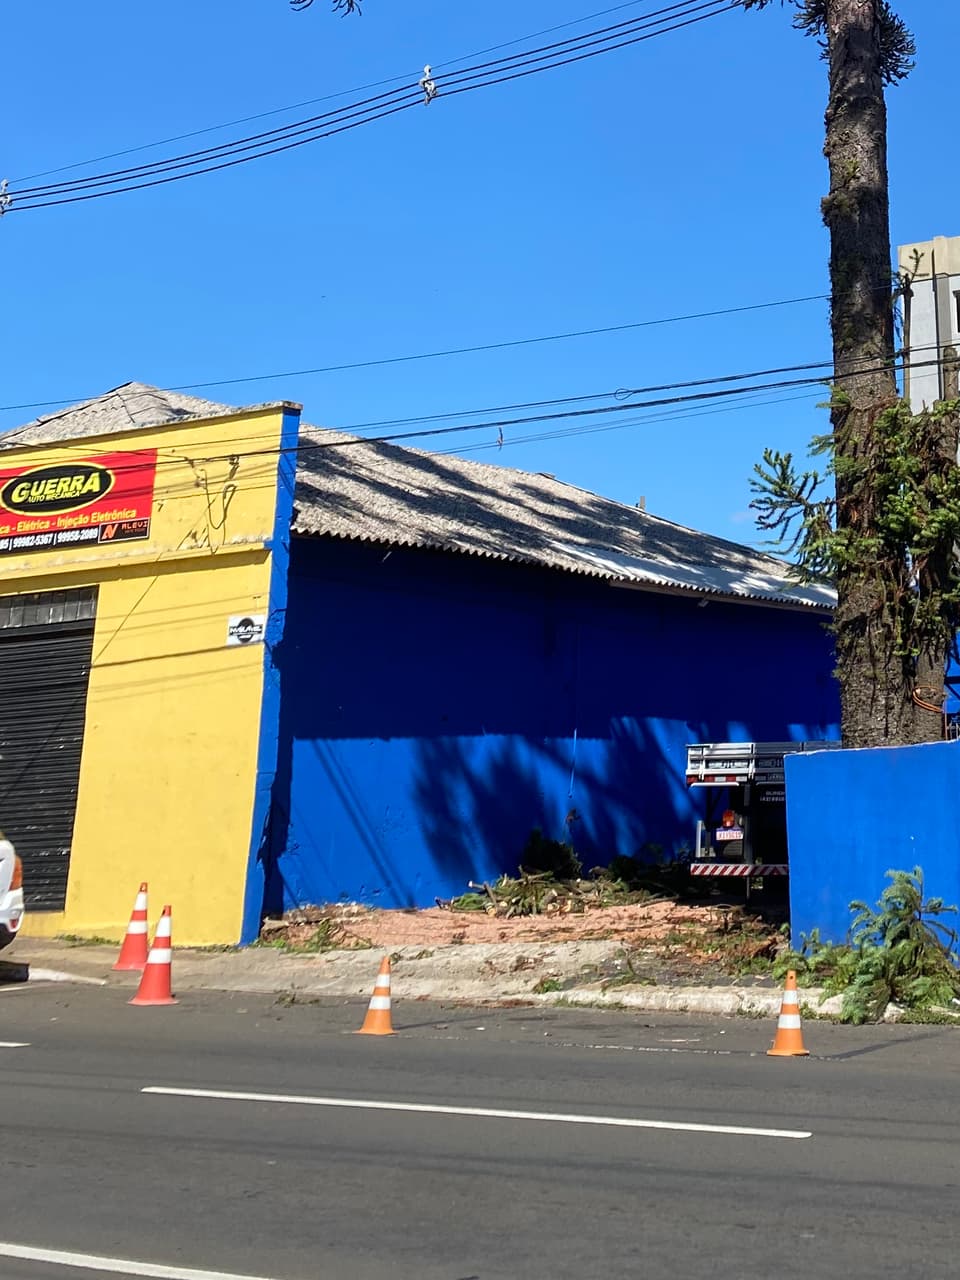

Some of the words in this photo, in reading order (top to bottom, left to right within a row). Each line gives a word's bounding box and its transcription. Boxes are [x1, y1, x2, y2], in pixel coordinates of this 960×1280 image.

[11, 472, 101, 503] GUERRA
[17, 519, 50, 532] Elétrica
[90, 509, 136, 523] Eletrônica
